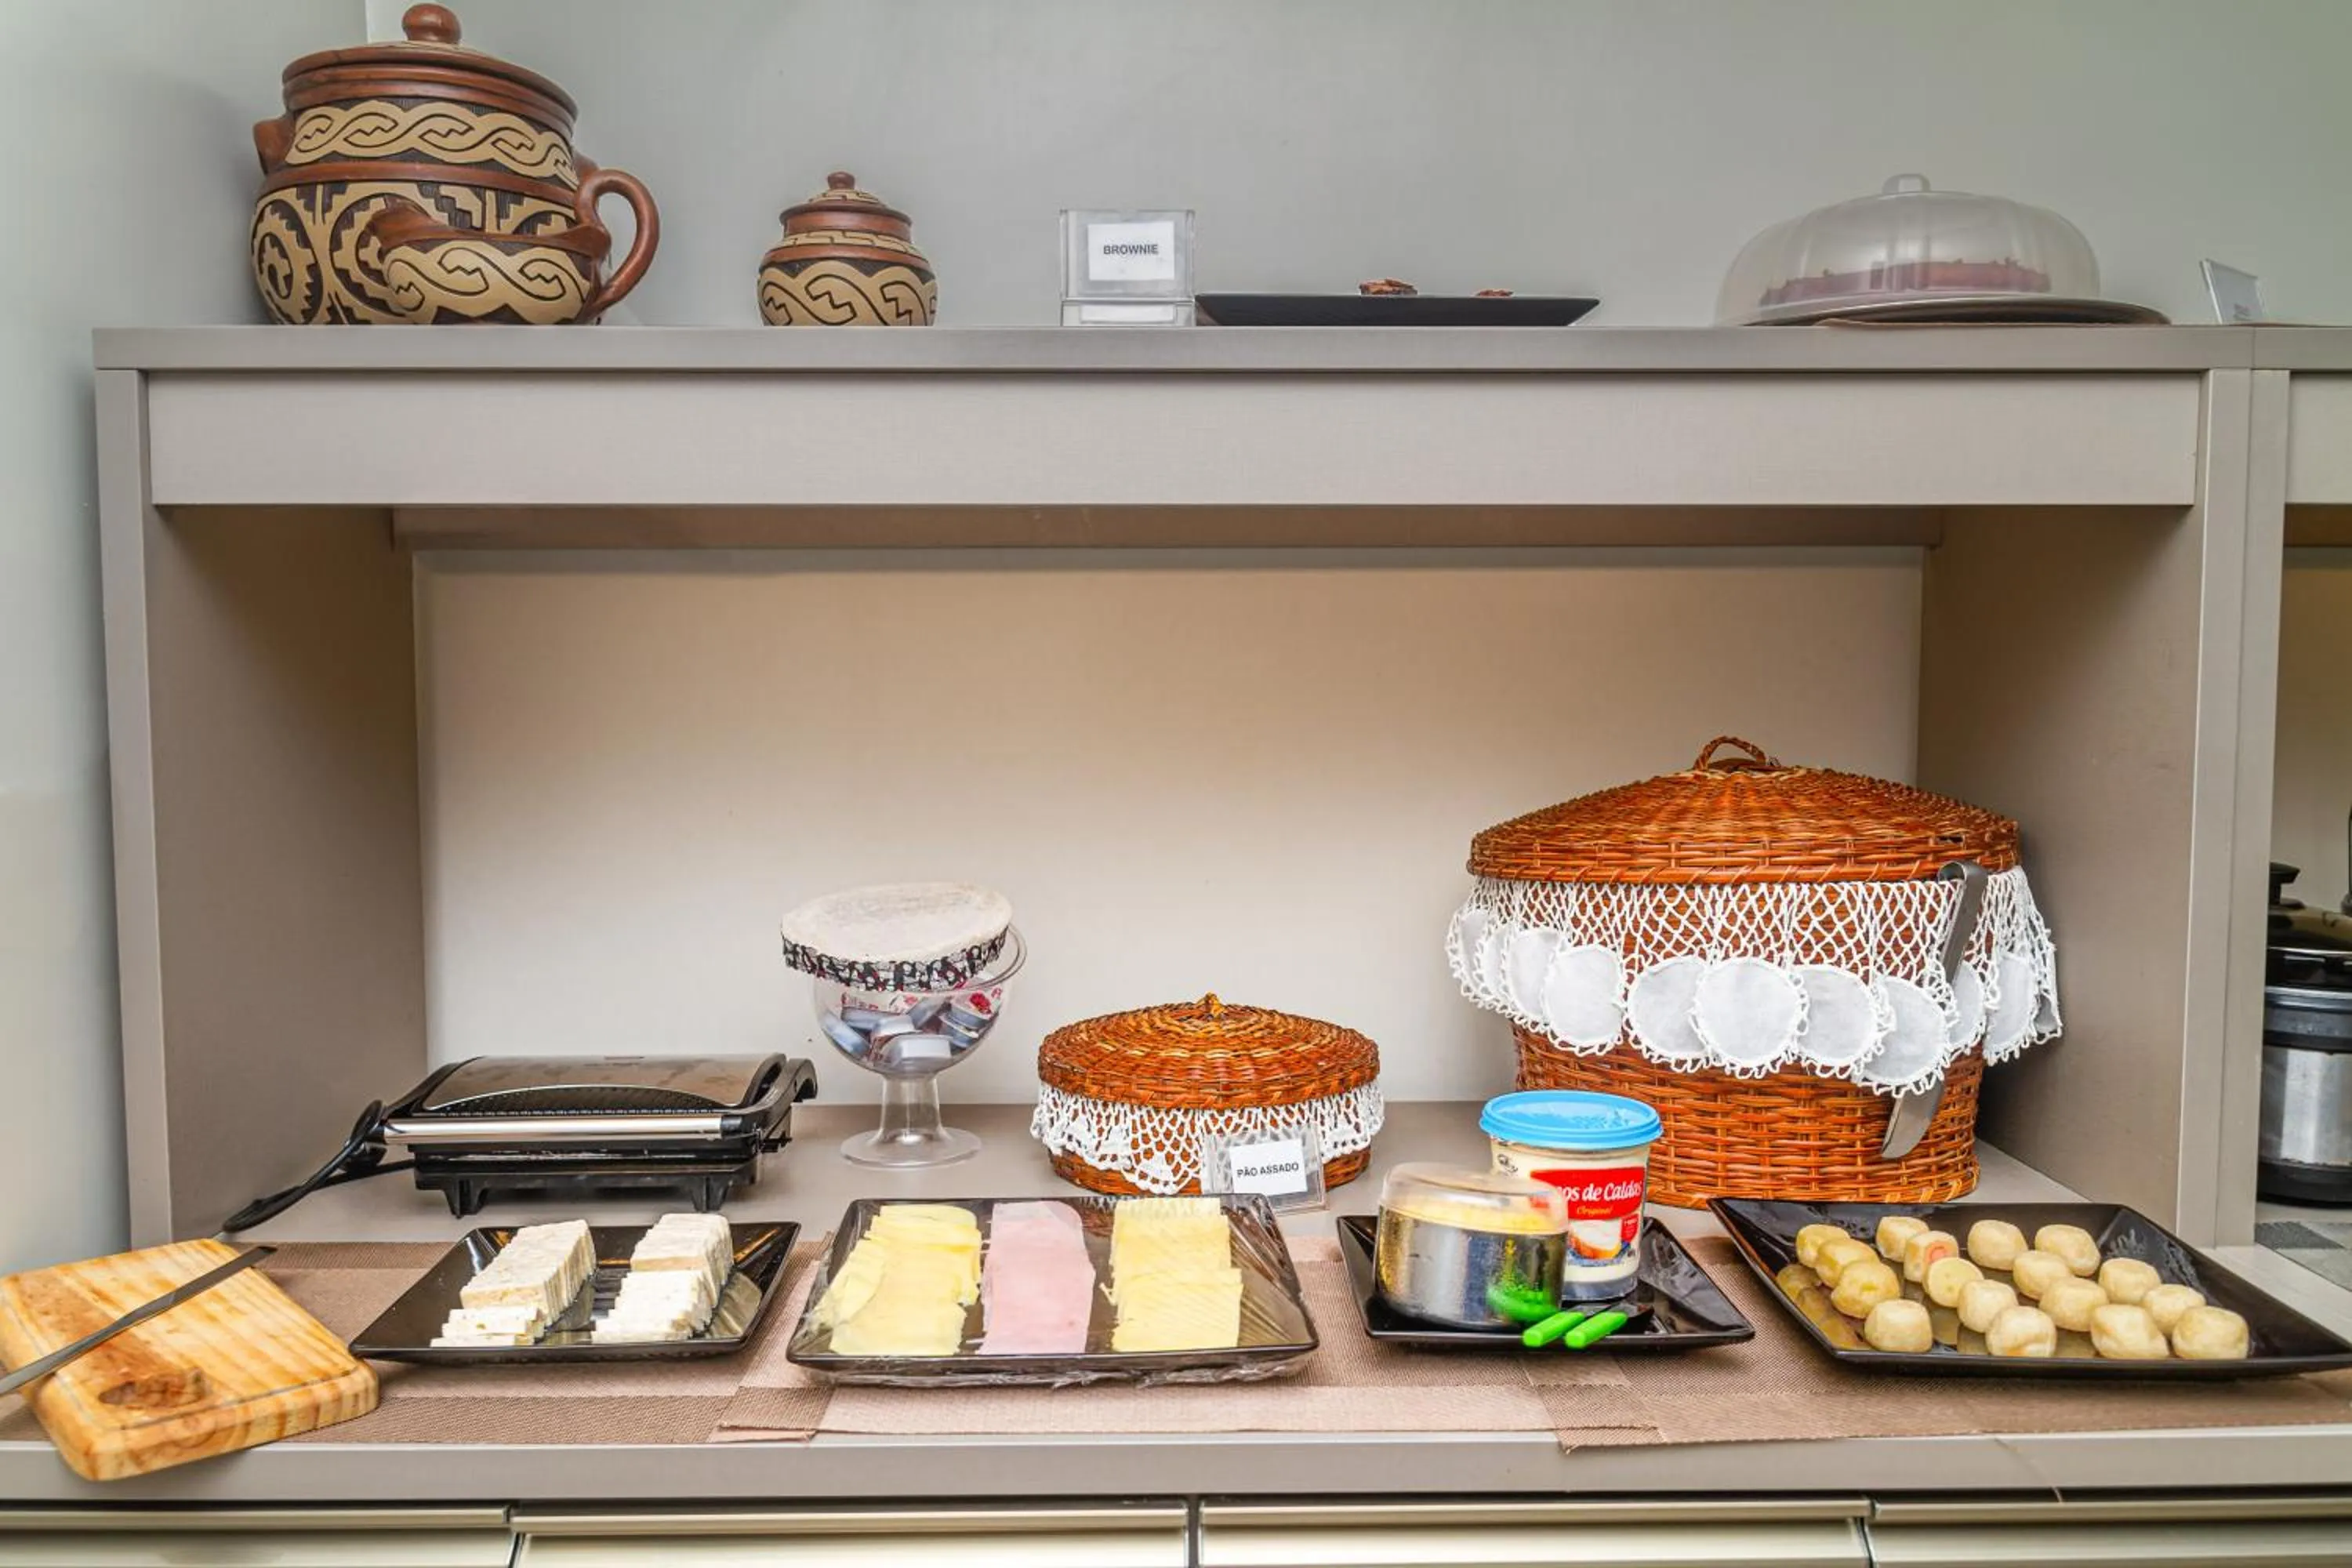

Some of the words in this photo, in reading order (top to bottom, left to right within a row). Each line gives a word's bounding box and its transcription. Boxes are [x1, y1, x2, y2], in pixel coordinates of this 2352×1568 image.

[1103, 244, 1159, 255] BROWNIE
[1236, 1165, 1258, 1178] PÃO
[1260, 1162, 1299, 1175] ASSADO
[1581, 1182, 1602, 1202] de
